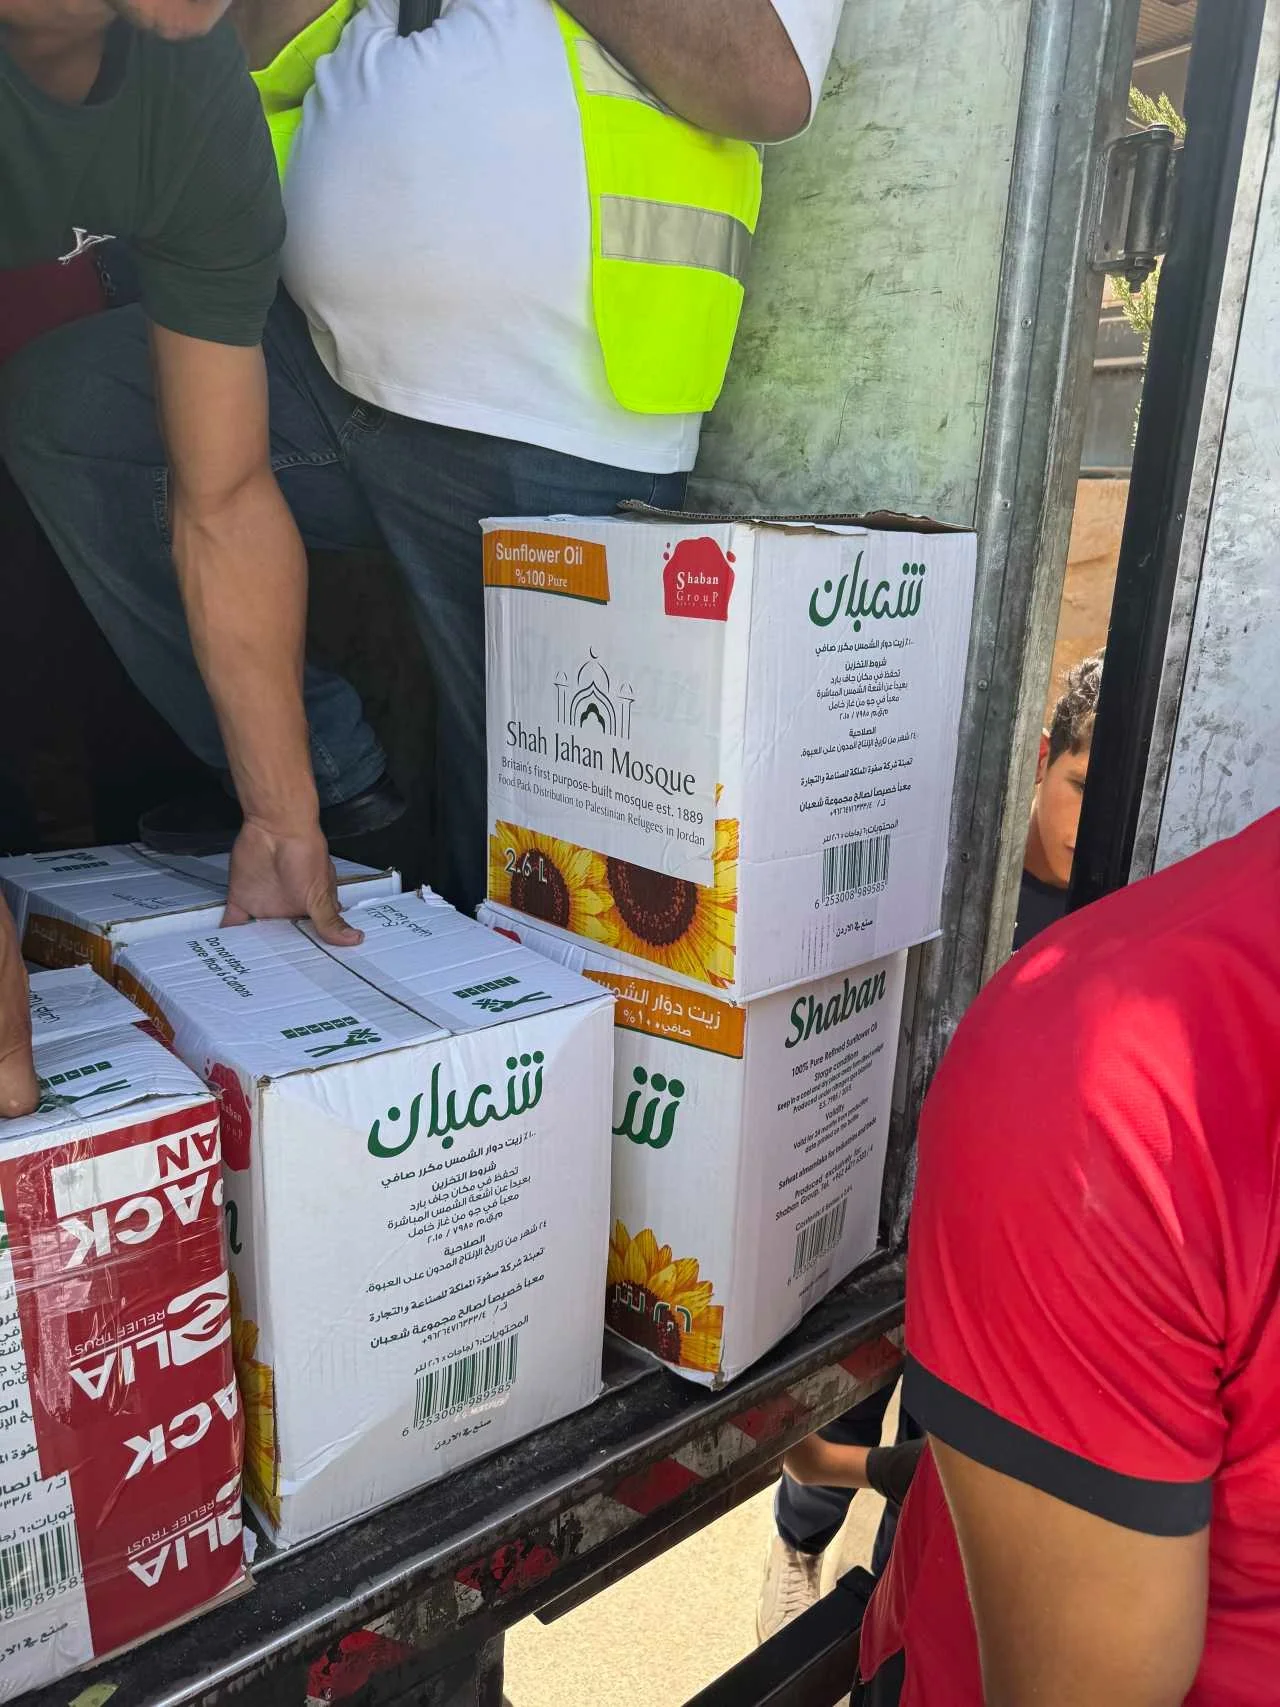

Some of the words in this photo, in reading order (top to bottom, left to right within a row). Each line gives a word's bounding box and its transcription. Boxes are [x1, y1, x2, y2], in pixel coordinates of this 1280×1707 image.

[496, 542, 561, 563] Sunflower
[564, 547, 583, 565] Oil
[515, 569, 545, 587] %100
[548, 575, 568, 588] Pure
[676, 571, 719, 590] Shaban
[809, 550, 926, 633] شعبان
[815, 643, 836, 656] صافي
[854, 638, 880, 652] الشمس
[868, 656, 887, 669] شروط
[848, 726, 877, 739] الصلاحية
[506, 720, 547, 755] Shah
[554, 732, 603, 771] Jahan
[501, 755, 532, 775] Britain's
[533, 764, 550, 781] first
[552, 773, 612, 799] purpose-built
[614, 791, 654, 811] mosque
[655, 803, 674, 817] est.
[677, 807, 703, 825] 1889
[853, 789, 873, 802] لصالح
[497, 772, 516, 787] Food
[532, 783, 574, 806] Distribution
[575, 797, 584, 809] to
[585, 799, 625, 821] Palestinian
[627, 812, 664, 834] Refugees
[666, 824, 674, 837] in
[676, 827, 705, 846] Jordan
[799, 797, 824, 812] شعبان
[824, 795, 853, 806] مجموعة
[504, 848, 532, 877] 2.6
[538, 858, 548, 884] L
[814, 898, 820, 910] 6
[824, 889, 855, 907] 253008
[857, 881, 885, 898] 989585
[687, 1005, 721, 1031] زيت
[785, 970, 886, 1048] Shaban
[661, 1022, 692, 1038] صافي
[792, 1060, 809, 1077] 100%
[809, 1055, 824, 1068] Pure
[824, 1040, 846, 1061] Refined
[367, 1050, 545, 1158] شعبان
[485, 1143, 503, 1156] دوار
[504, 1134, 522, 1147] زيت
[157, 1124, 219, 1179] AN
[444, 1147, 483, 1168] الشمس
[417, 1162, 443, 1178] مكرر
[468, 1160, 497, 1178] شروط
[493, 1166, 519, 1183] تحفظ
[381, 1171, 416, 1189] صافي
[431, 1171, 467, 1192] التخزين
[477, 1175, 492, 1191] في
[427, 1193, 449, 1205] جاف
[450, 1184, 475, 1198] مكان
[494, 1184, 508, 1196] عن
[409, 1199, 426, 1211] بارد
[430, 1197, 467, 1218] الشمس
[482, 1198, 498, 1215] في
[499, 1193, 519, 1206] معبأ
[387, 1210, 429, 1230] المباشرة
[452, 1213, 466, 1224] من
[468, 1207, 481, 1218] جو
[407, 1222, 435, 1238] خامل
[436, 1216, 450, 1230] غاز
[452, 1222, 474, 1234] ٧٩٨٥
[519, 1223, 538, 1241] شهر
[443, 1234, 485, 1256] الصلاحية
[484, 1239, 503, 1255] تاريخ
[504, 1235, 518, 1247] من
[522, 1247, 544, 1263] تعبئة
[425, 1257, 457, 1277] المدون
[501, 1258, 522, 1273] شركة
[402, 1271, 425, 1284] على
[480, 1270, 499, 1285] صفوة
[524, 1274, 545, 1288] معبأ
[410, 1289, 448, 1309] للصناعة
[612, 1281, 646, 1313] لتر
[369, 1305, 409, 1323] والتجارة
[457, 1298, 486, 1319] لصالح
[119, 1308, 166, 1337] RELIEF
[412, 1314, 456, 1334] مجموعة
[68, 1332, 113, 1358] TRUST
[370, 1327, 410, 1349] شعبان
[401, 1426, 409, 1437] 6
[417, 1402, 463, 1431] 253008
[468, 1380, 511, 1408] 989585
[472, 1419, 492, 1434] صنع
[171, 1500, 215, 1531] RELIEF
[126, 1530, 169, 1555] TRUST
[40, 1622, 68, 1643] صنع
